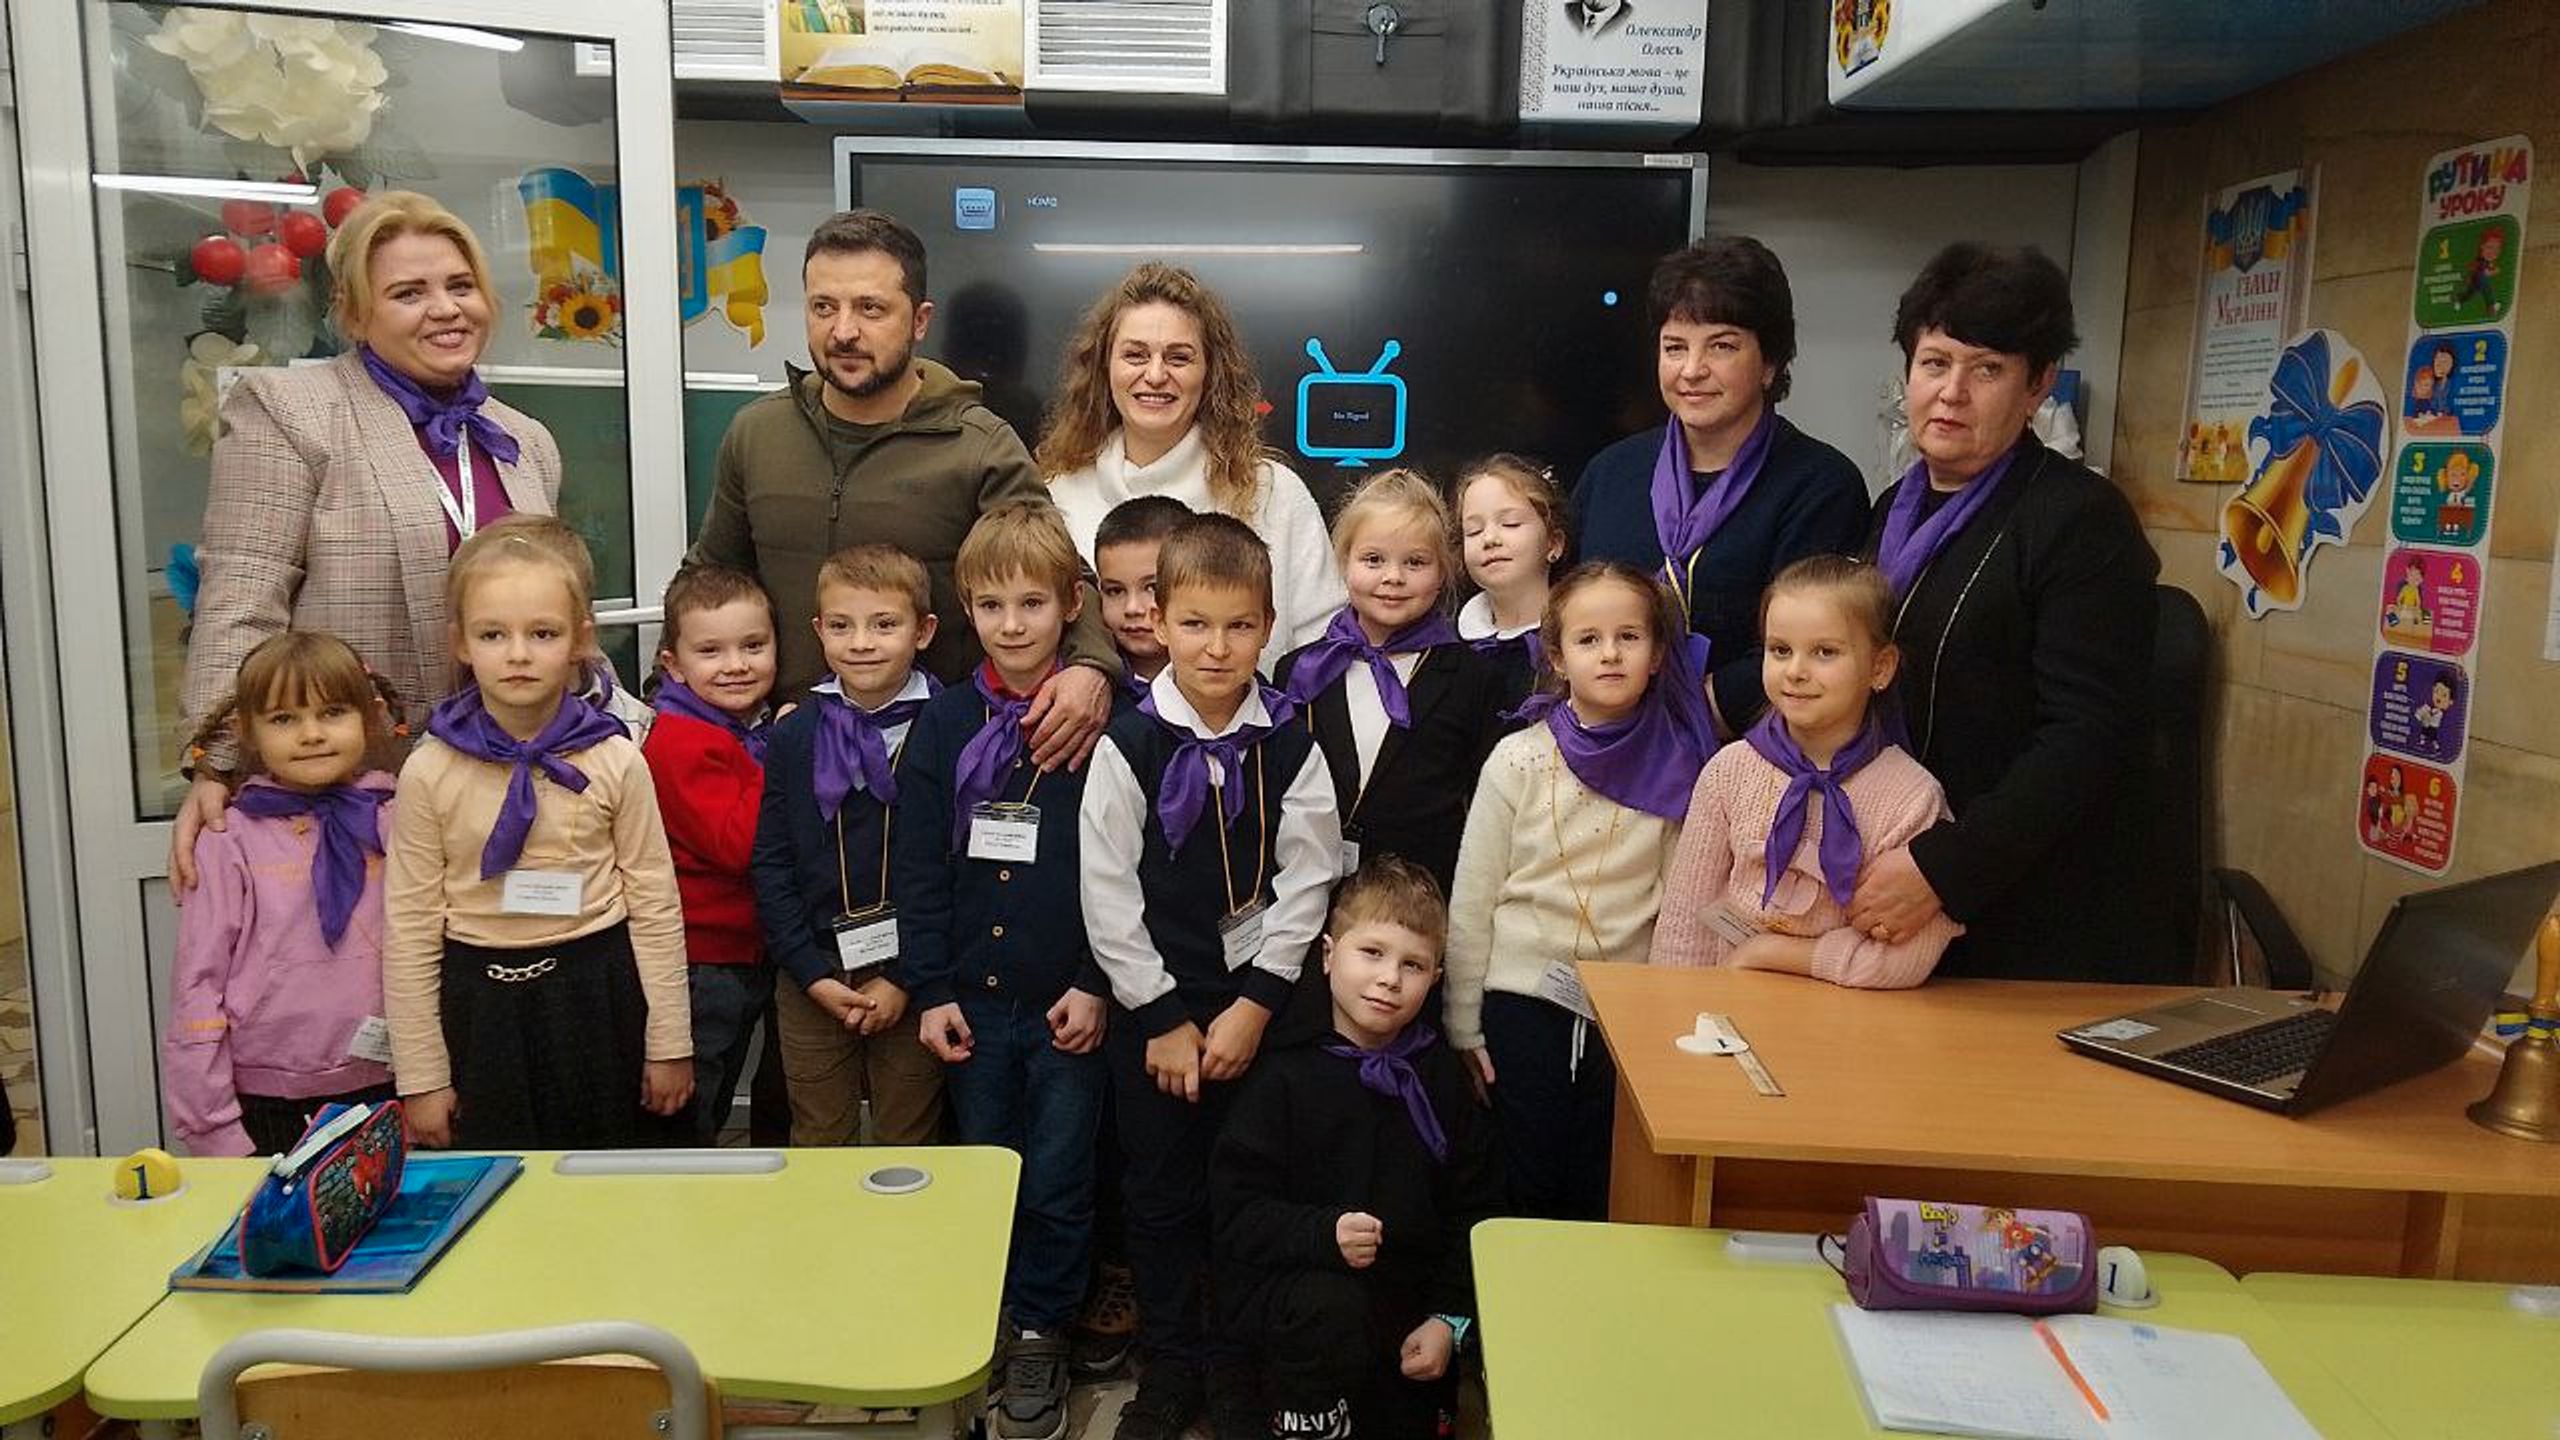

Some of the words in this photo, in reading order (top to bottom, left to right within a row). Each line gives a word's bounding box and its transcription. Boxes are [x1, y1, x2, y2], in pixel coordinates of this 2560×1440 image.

[1625, 23, 1702, 40] Олександр
[1641, 43, 1684, 56] Олесь
[1551, 64, 1625, 79] Українська
[1626, 68, 1662, 78] мова
[1674, 68, 1690, 80] це
[1553, 83, 1581, 93] наш
[1611, 84, 1648, 94] наша
[1577, 100, 1614, 111] наша
[2428, 147, 2528, 204] РУТИНА
[2438, 184, 2506, 219] УРОКУ
[2439, 238, 2449, 259] 1
[2474, 339, 2488, 362] 2
[1333, 411, 1345, 420] No
[2413, 452, 2426, 474] 3
[2450, 561, 2465, 585] 4
[2395, 661, 2409, 683] 5
[2429, 777, 2442, 798] 6
[130, 1162, 154, 1201] 1
[2106, 1262, 2118, 1296] 1
